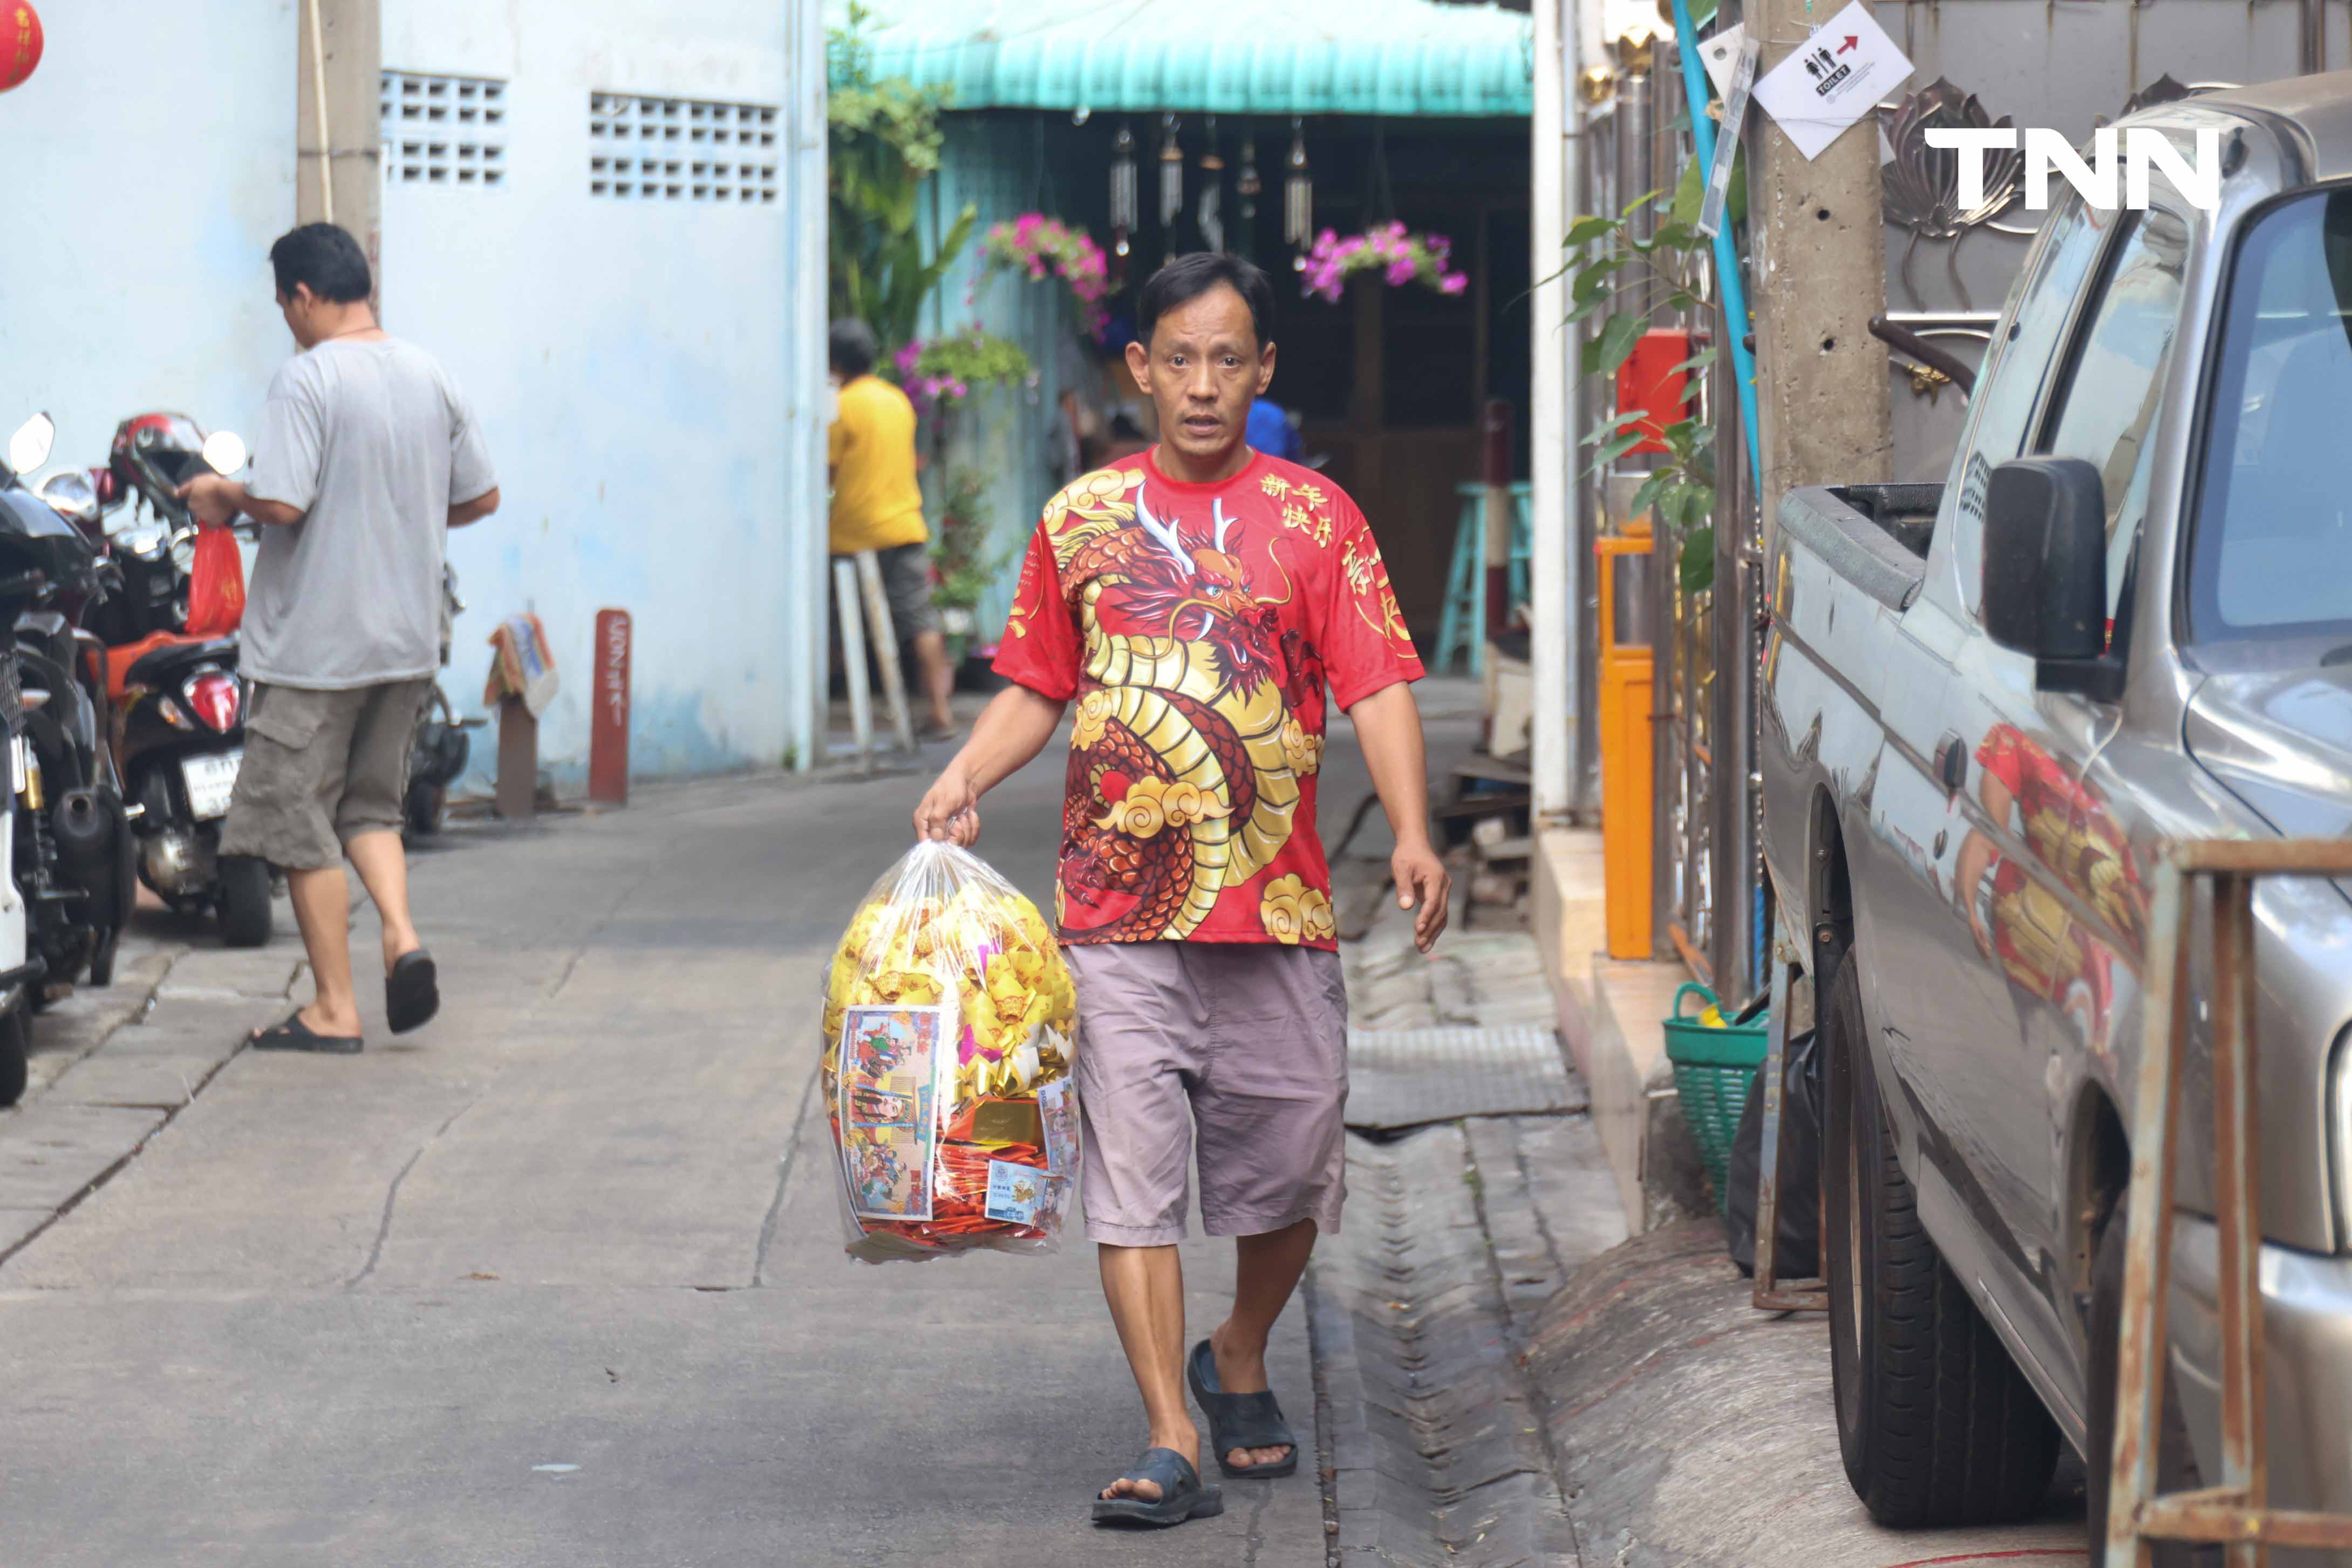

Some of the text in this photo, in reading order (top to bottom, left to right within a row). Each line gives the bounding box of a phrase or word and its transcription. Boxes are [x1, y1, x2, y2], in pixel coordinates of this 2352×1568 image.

[1818, 66, 1847, 94] TOILET
[1260, 473, 1328, 512] 新年
[1281, 502, 1332, 549] 快乐
